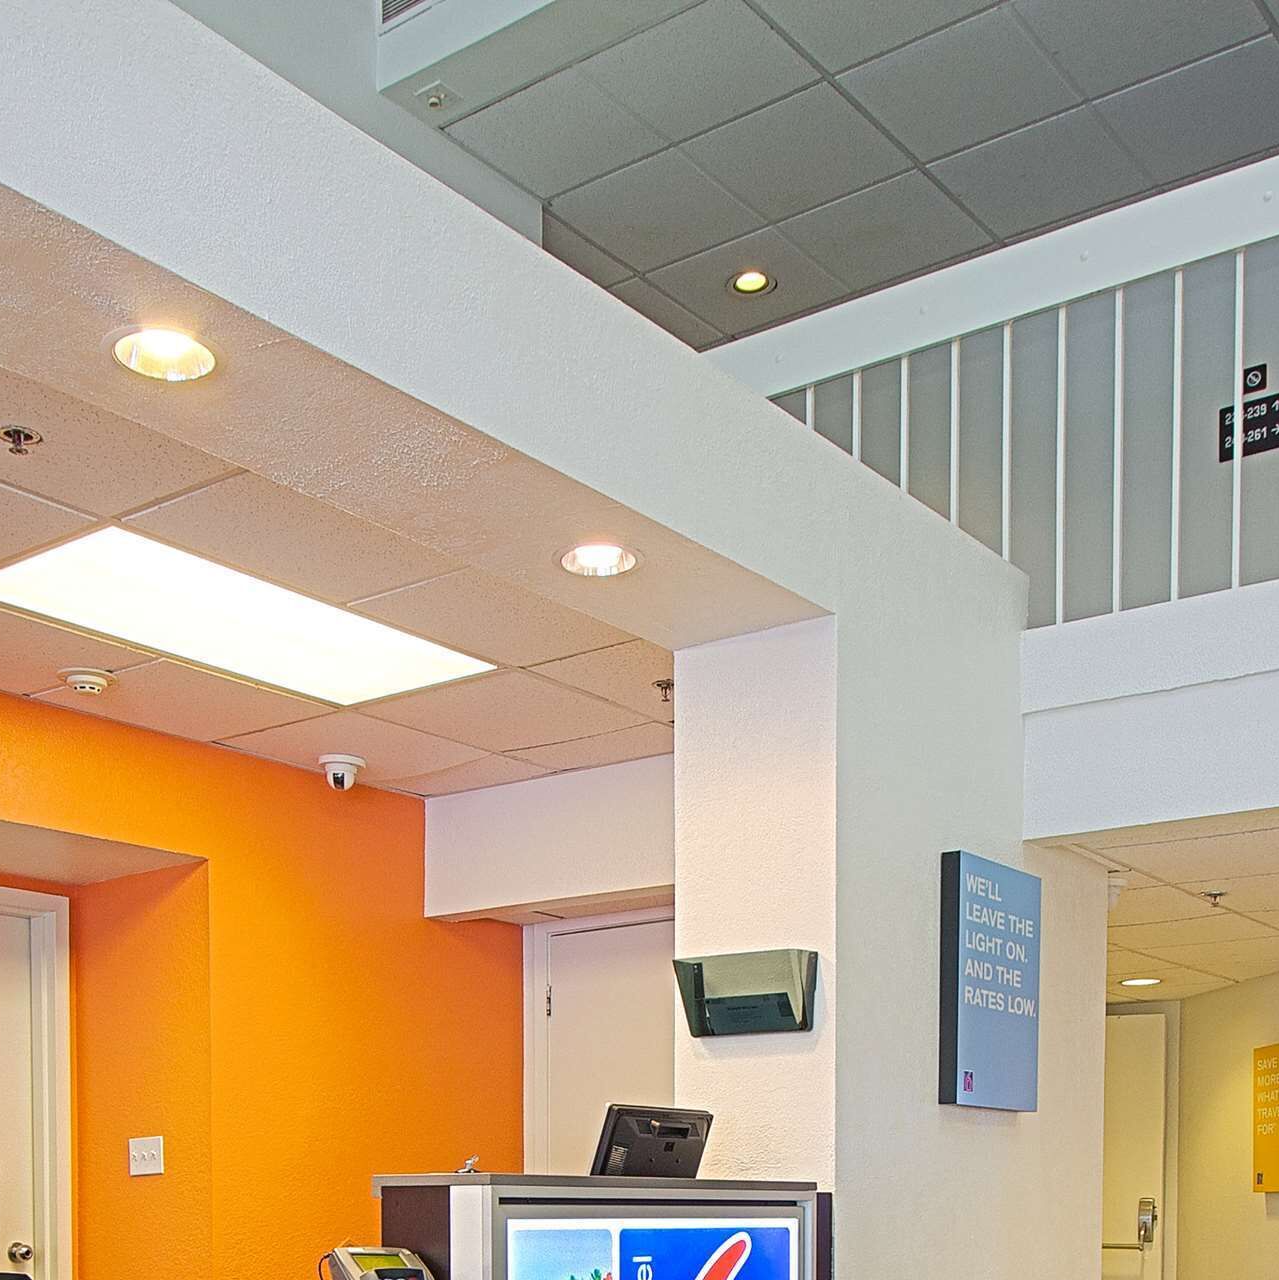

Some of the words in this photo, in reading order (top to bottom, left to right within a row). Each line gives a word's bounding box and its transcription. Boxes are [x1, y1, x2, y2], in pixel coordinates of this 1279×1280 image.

[966, 873, 1002, 902] WE'LL
[965, 904, 1005, 930] LEAVE
[1008, 915, 1034, 938] THE
[965, 929, 1003, 956] LIGHT
[1006, 942, 1028, 963] ON.
[964, 959, 993, 981] AND
[996, 966, 1022, 988] THE
[964, 986, 1005, 1012] RATES
[1008, 997, 1036, 1017] LOW.
[1257, 1057, 1278, 1071] SAVE
[1257, 1091, 1279, 1103] WHAT
